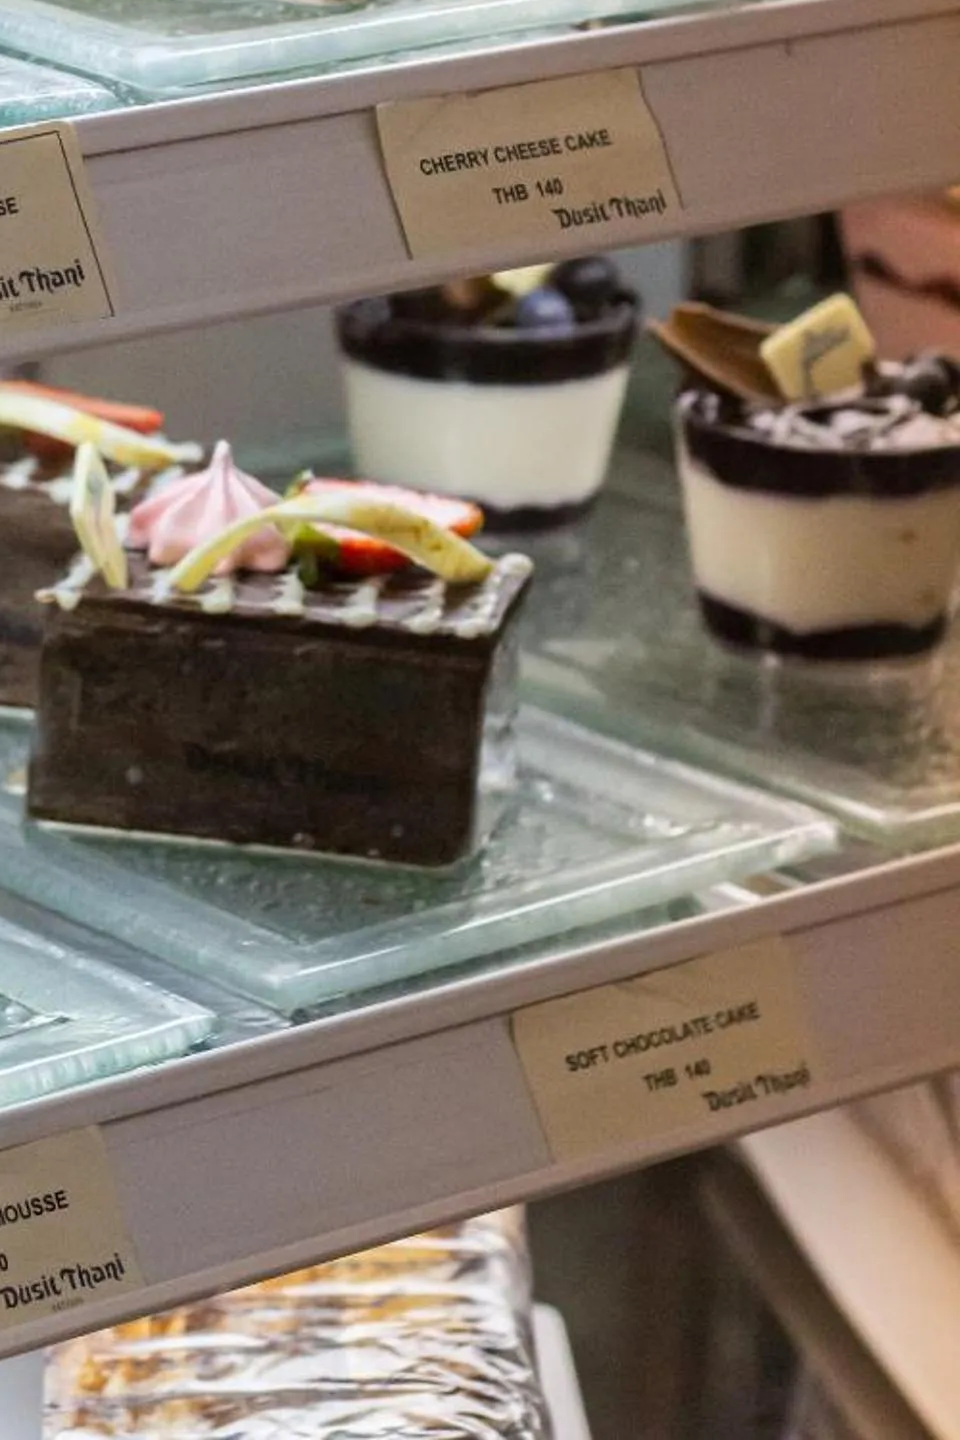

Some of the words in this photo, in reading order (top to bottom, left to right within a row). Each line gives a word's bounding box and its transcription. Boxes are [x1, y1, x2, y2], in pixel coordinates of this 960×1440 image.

[420, 149, 490, 176] CHERRY
[493, 137, 563, 164] CHEESE
[564, 128, 612, 151] CAKE
[492, 182, 528, 205] THB
[535, 177, 563, 198] 140
[551, 205, 611, 229] Dusit
[608, 189, 667, 220] Thani
[19, 258, 86, 294] Thani
[565, 1045, 609, 1072] SOFT
[612, 1017, 714, 1059] CHOCOLATE
[713, 1000, 761, 1030] CAKE
[643, 1067, 678, 1091] THB
[684, 1057, 711, 1080] 140
[60, 1251, 126, 1291] Thani
